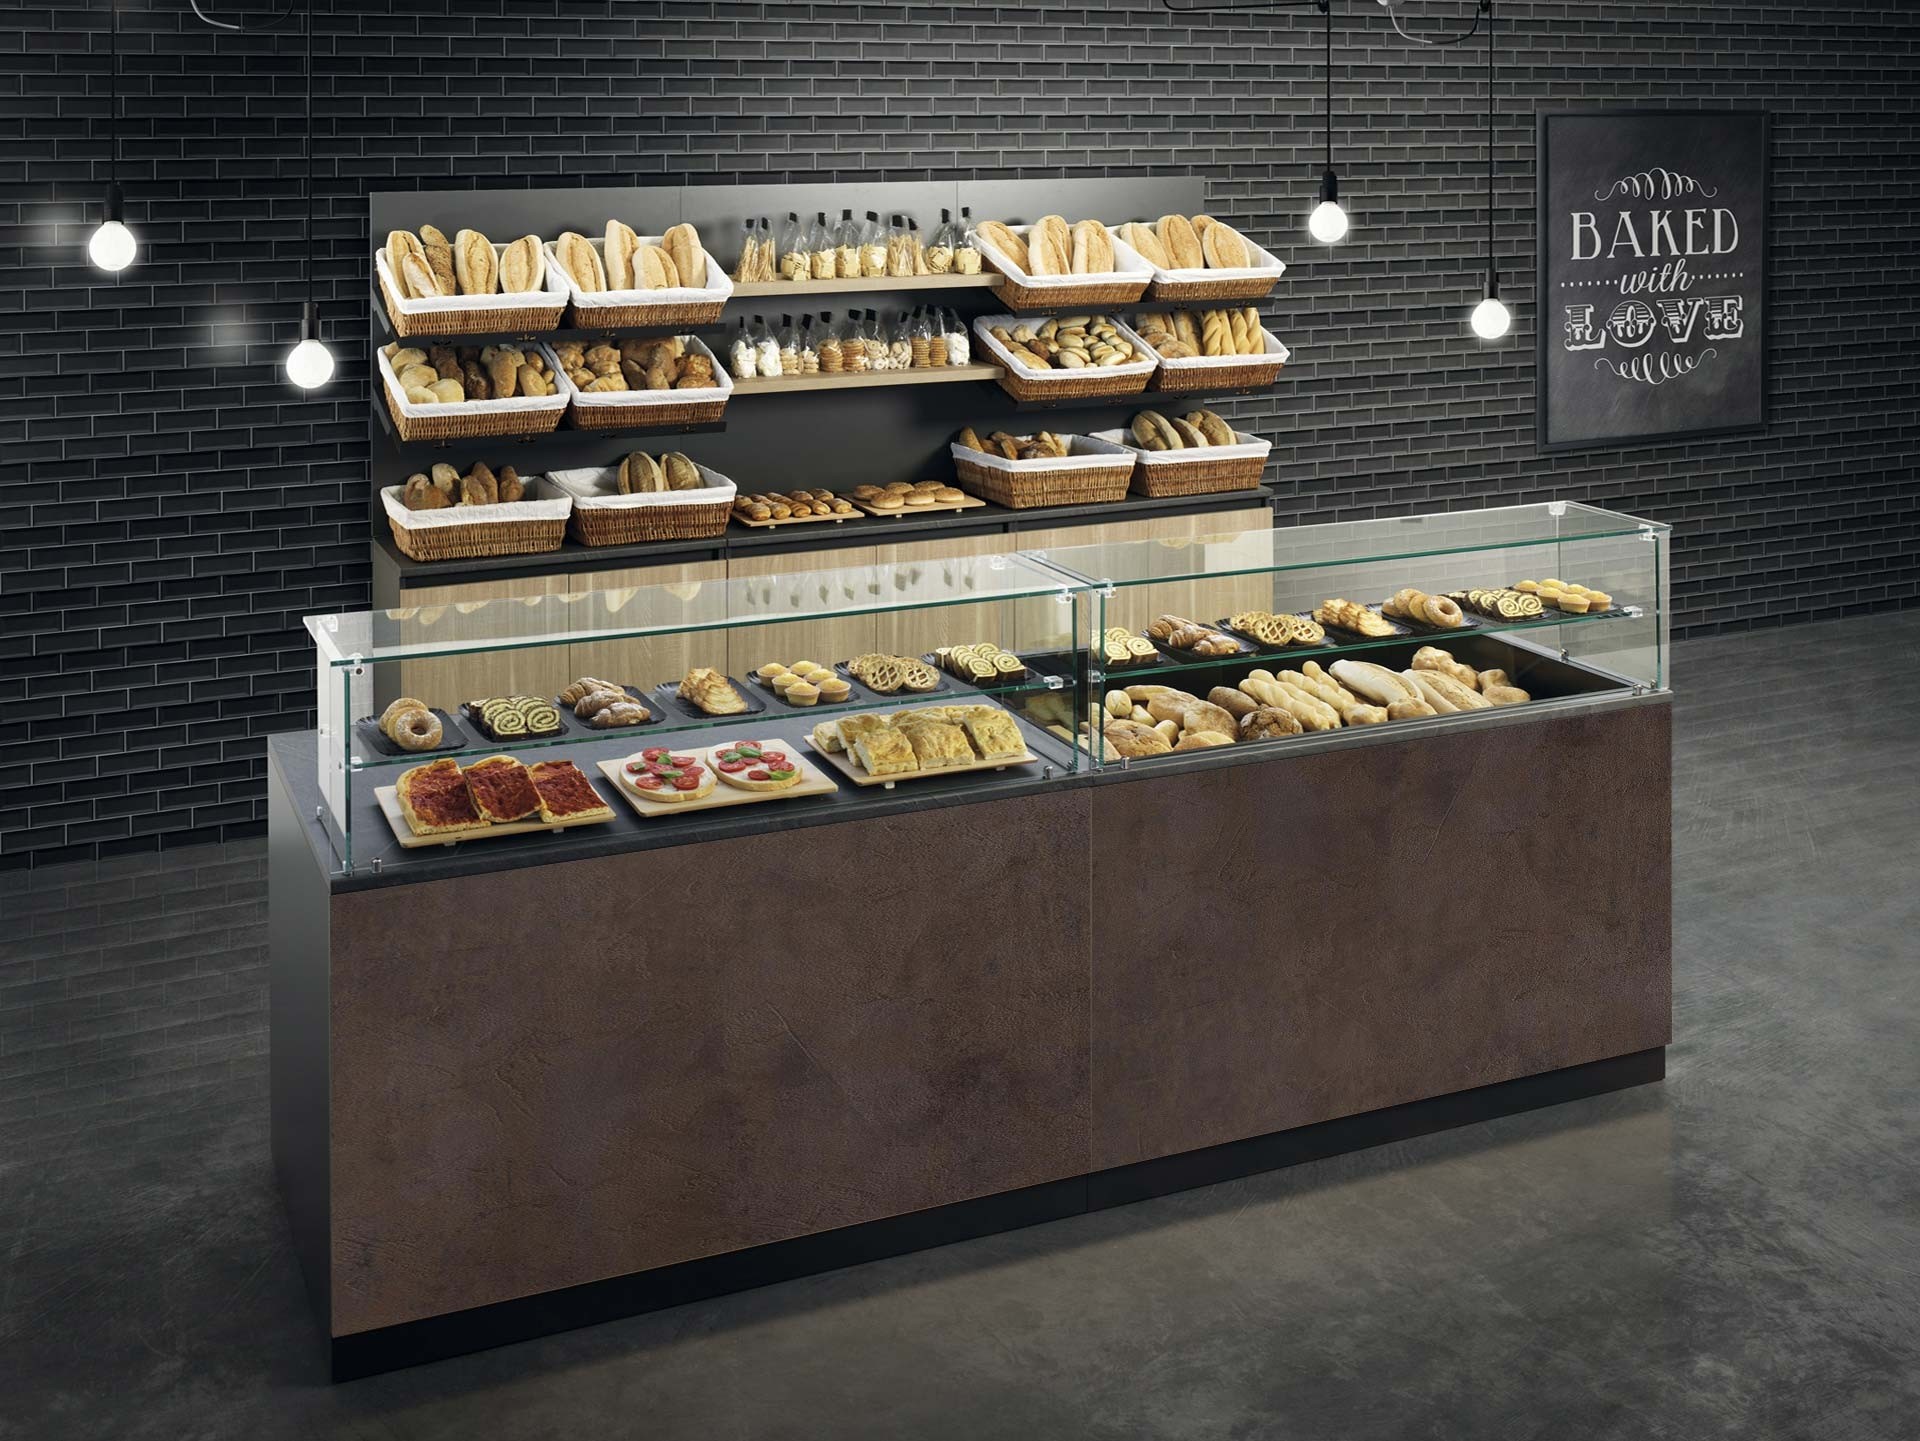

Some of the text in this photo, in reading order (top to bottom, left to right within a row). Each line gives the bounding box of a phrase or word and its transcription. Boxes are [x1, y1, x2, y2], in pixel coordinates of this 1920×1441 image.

[1570, 208, 1739, 261] BAKED
[1620, 258, 1694, 294] with
[1564, 295, 1744, 351] LOVE
